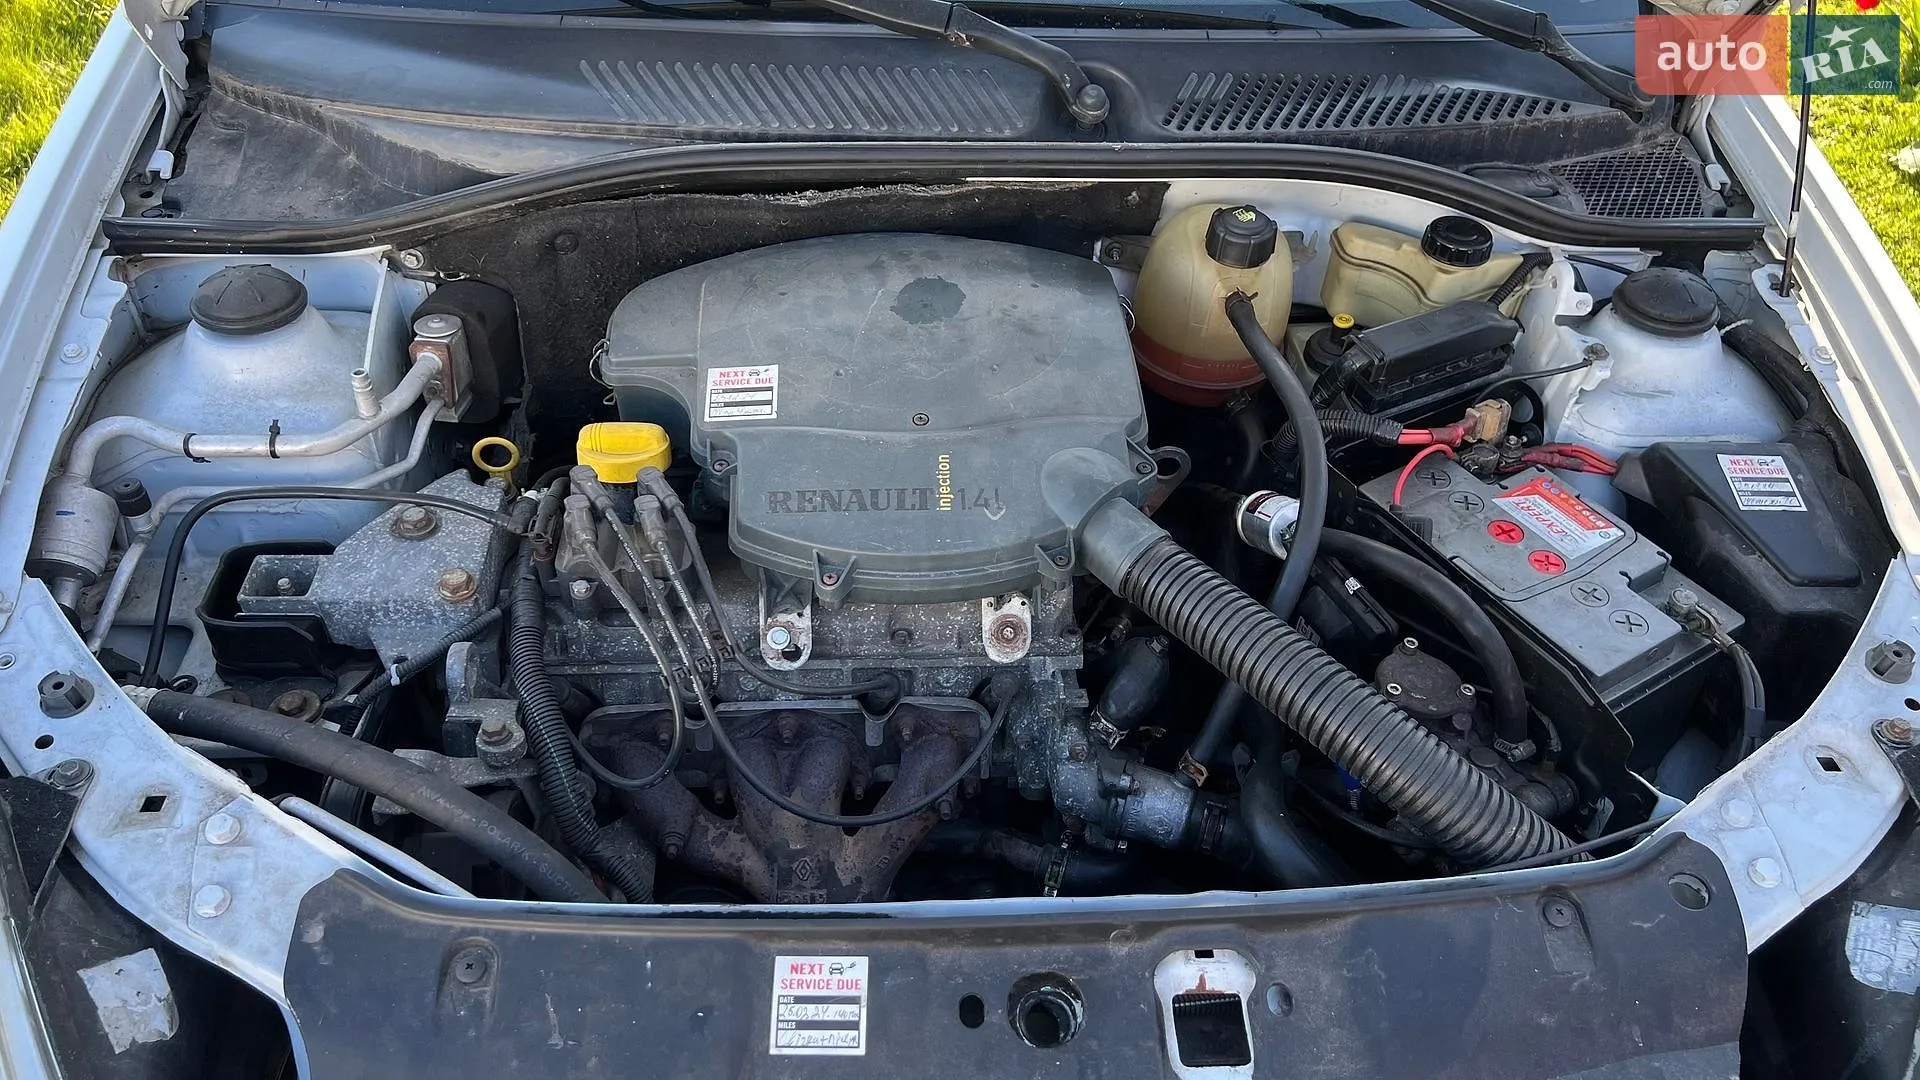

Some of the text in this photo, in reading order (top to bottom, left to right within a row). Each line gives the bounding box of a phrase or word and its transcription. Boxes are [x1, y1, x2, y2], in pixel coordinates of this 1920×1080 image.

[719, 370, 746, 379] NEXT
[712, 377, 774, 387] SERVICE DUE
[1729, 458, 1754, 466] NEXT
[1728, 467, 1786, 475] SERVICE DUE
[937, 453, 953, 511] injection
[767, 487, 935, 514] RENAULT
[1511, 500, 1568, 534] EXPERT
[789, 962, 825, 975] NEXT
[780, 978, 862, 990] SERVICE DUE
[778, 1021, 796, 1029] MILES
